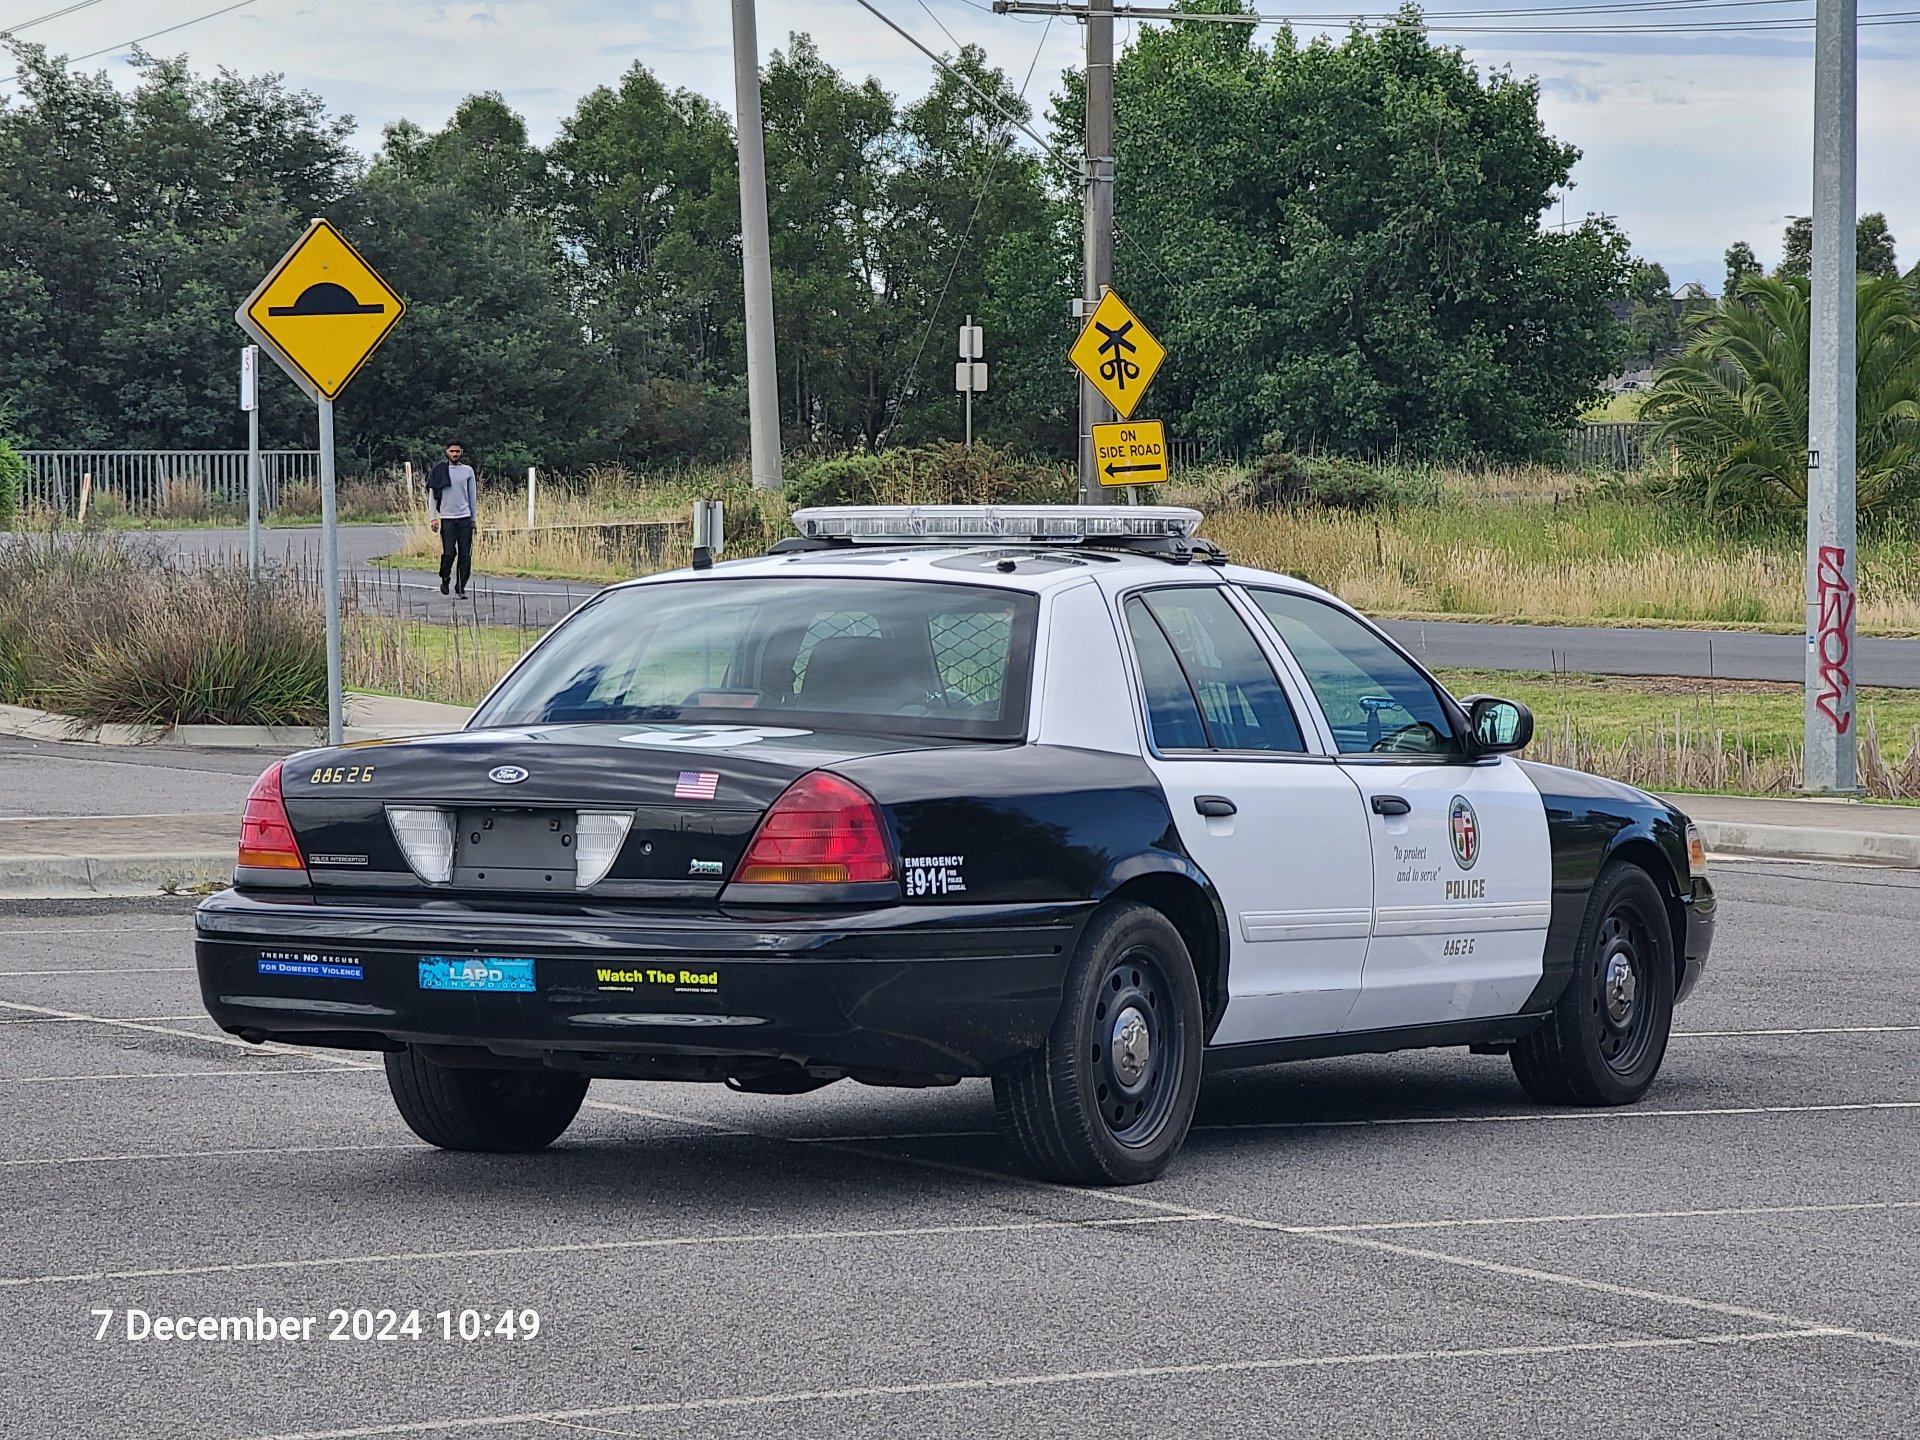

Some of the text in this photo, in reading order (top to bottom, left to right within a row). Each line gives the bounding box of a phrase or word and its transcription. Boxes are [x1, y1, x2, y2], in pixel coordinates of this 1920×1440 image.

[1120, 430, 1136, 442] ON
[1099, 443, 1161, 458] SIDE ROAD
[310, 766, 375, 784] 88626
[905, 856, 964, 867] EMERGENCY
[1403, 846, 1427, 863] protect
[906, 868, 914, 896] DIAL
[1396, 866, 1411, 882] and
[1412, 868, 1419, 882] to
[1445, 879, 1486, 900] POLICE
[1443, 938, 1475, 956] 88626
[261, 952, 360, 964] THERE'S NO EXCUSE
[449, 967, 503, 982] LAPD
[597, 969, 718, 985] Watch The Road
[427, 981, 526, 989] JOINLAPD.COM
